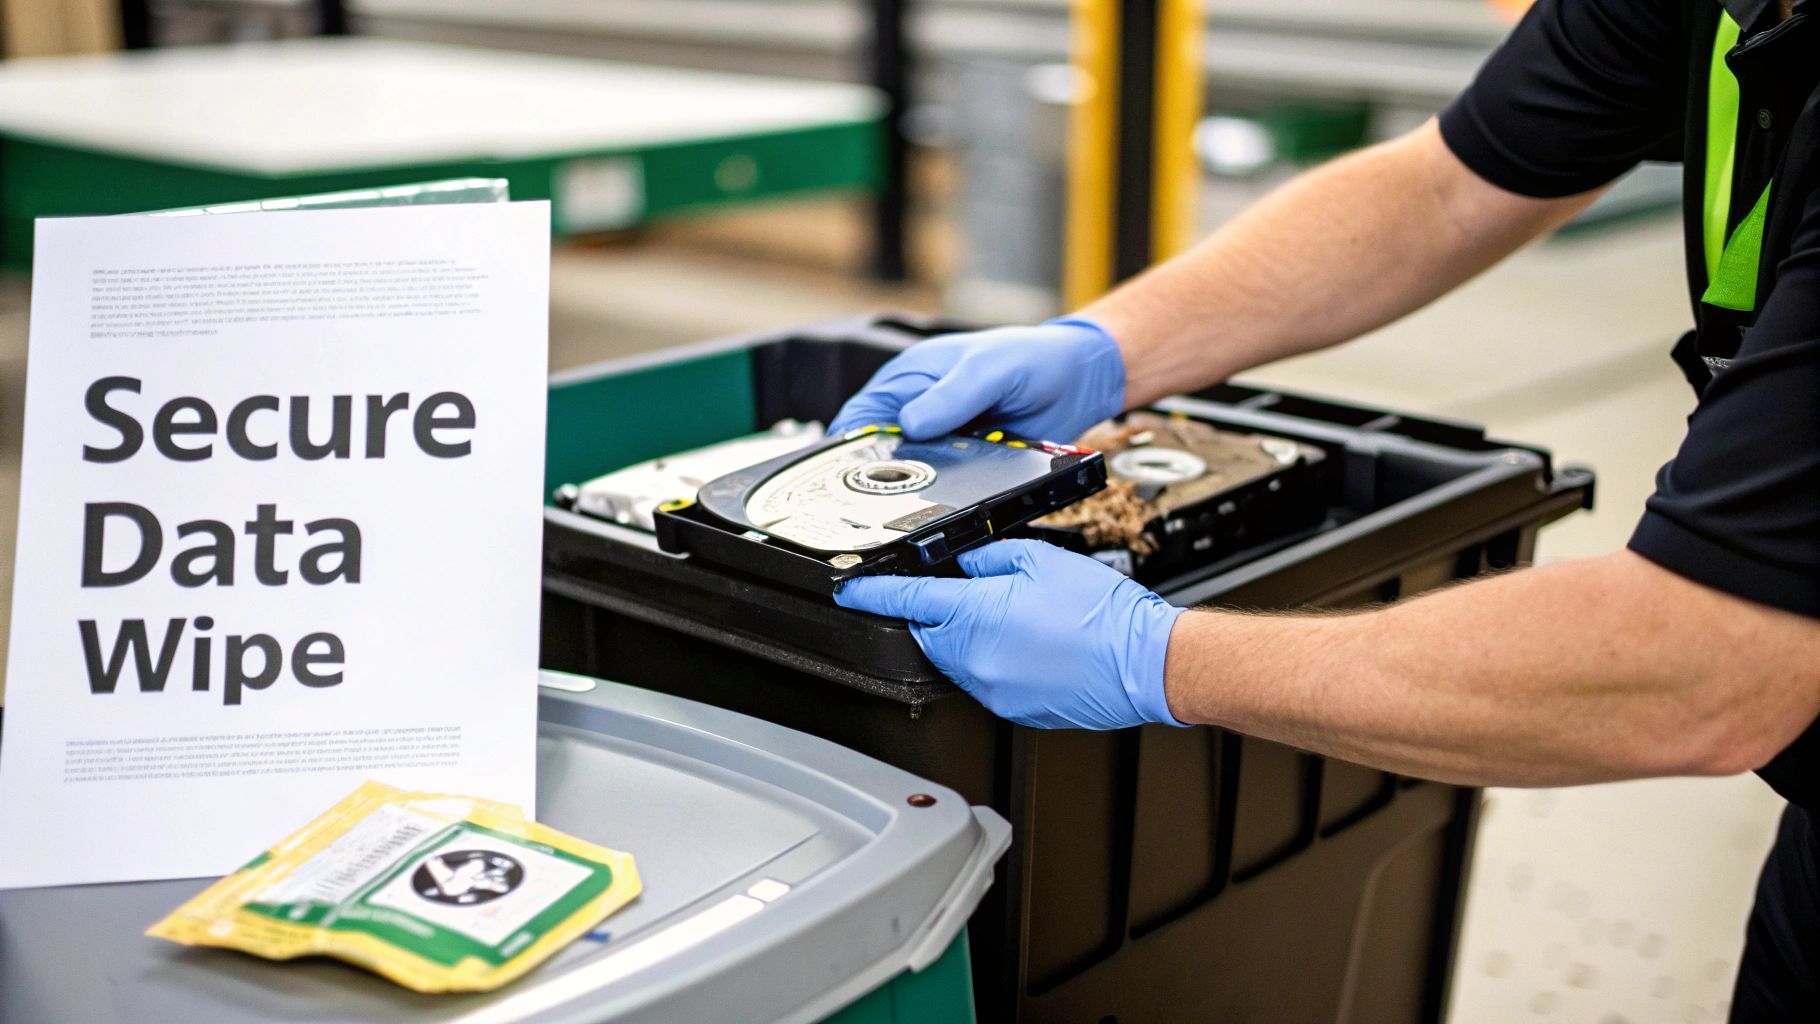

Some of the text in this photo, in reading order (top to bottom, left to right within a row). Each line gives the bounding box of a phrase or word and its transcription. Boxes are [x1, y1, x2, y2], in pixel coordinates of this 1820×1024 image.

[82, 375, 476, 464] Secure
[81, 501, 363, 588] Data
[78, 615, 346, 706] Wipe
